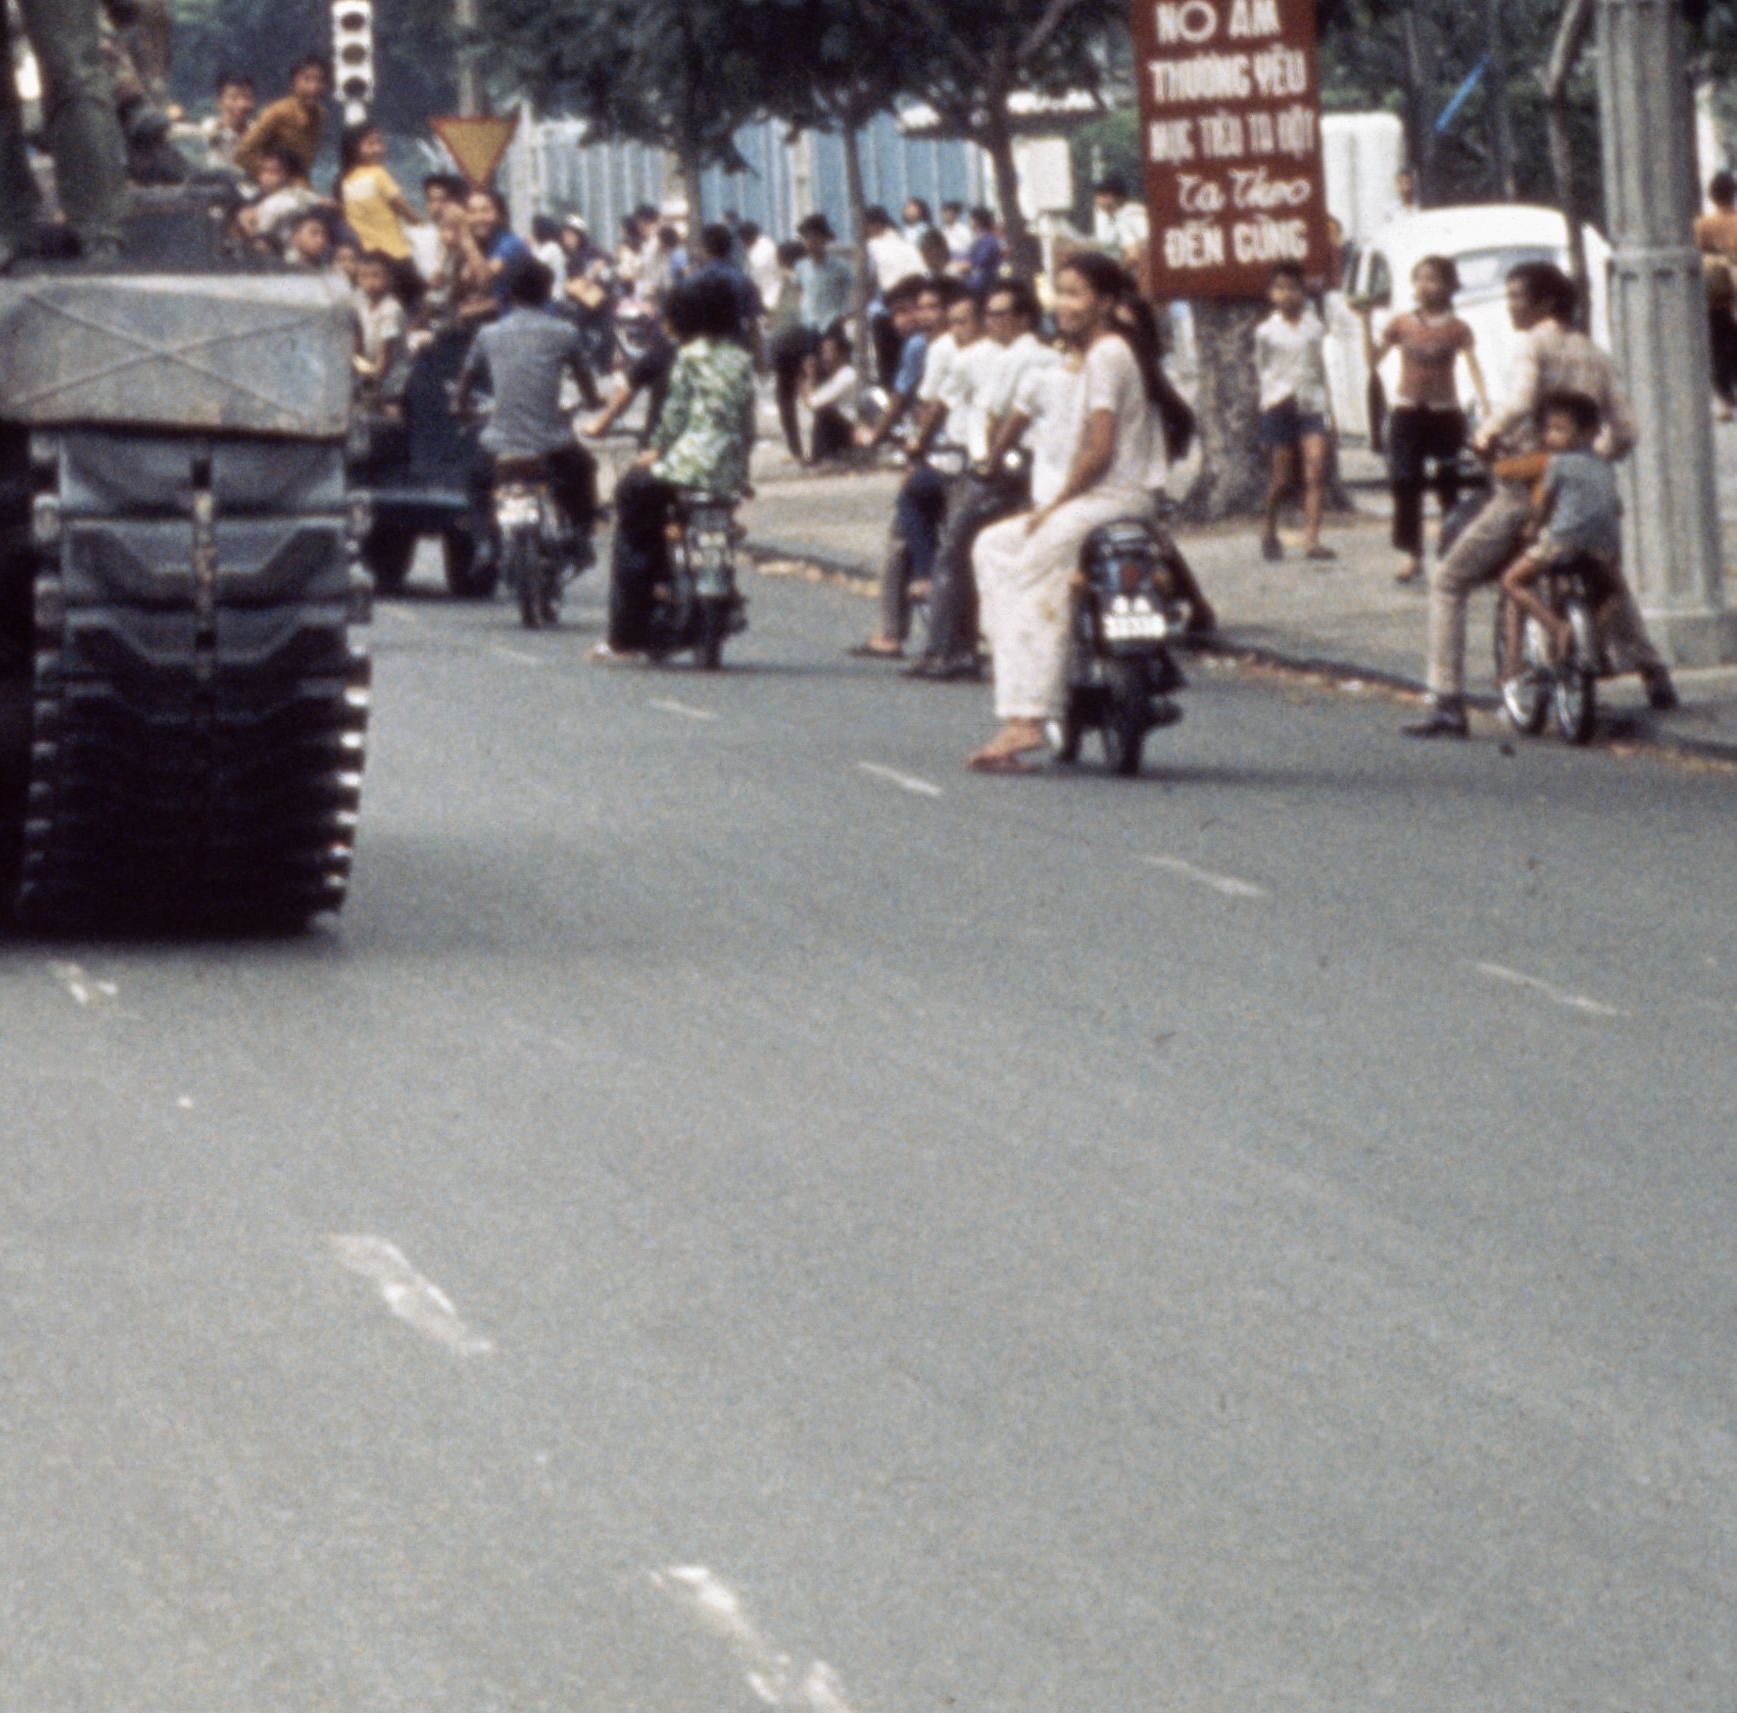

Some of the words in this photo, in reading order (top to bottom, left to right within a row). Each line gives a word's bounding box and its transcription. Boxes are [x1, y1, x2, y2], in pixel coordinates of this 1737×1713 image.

[1156, 0, 1217, 44] NO
[1253, 42, 1307, 96] YÊU
[1175, 173, 1226, 212] Ta
[1233, 212, 1309, 264] CÙNG
